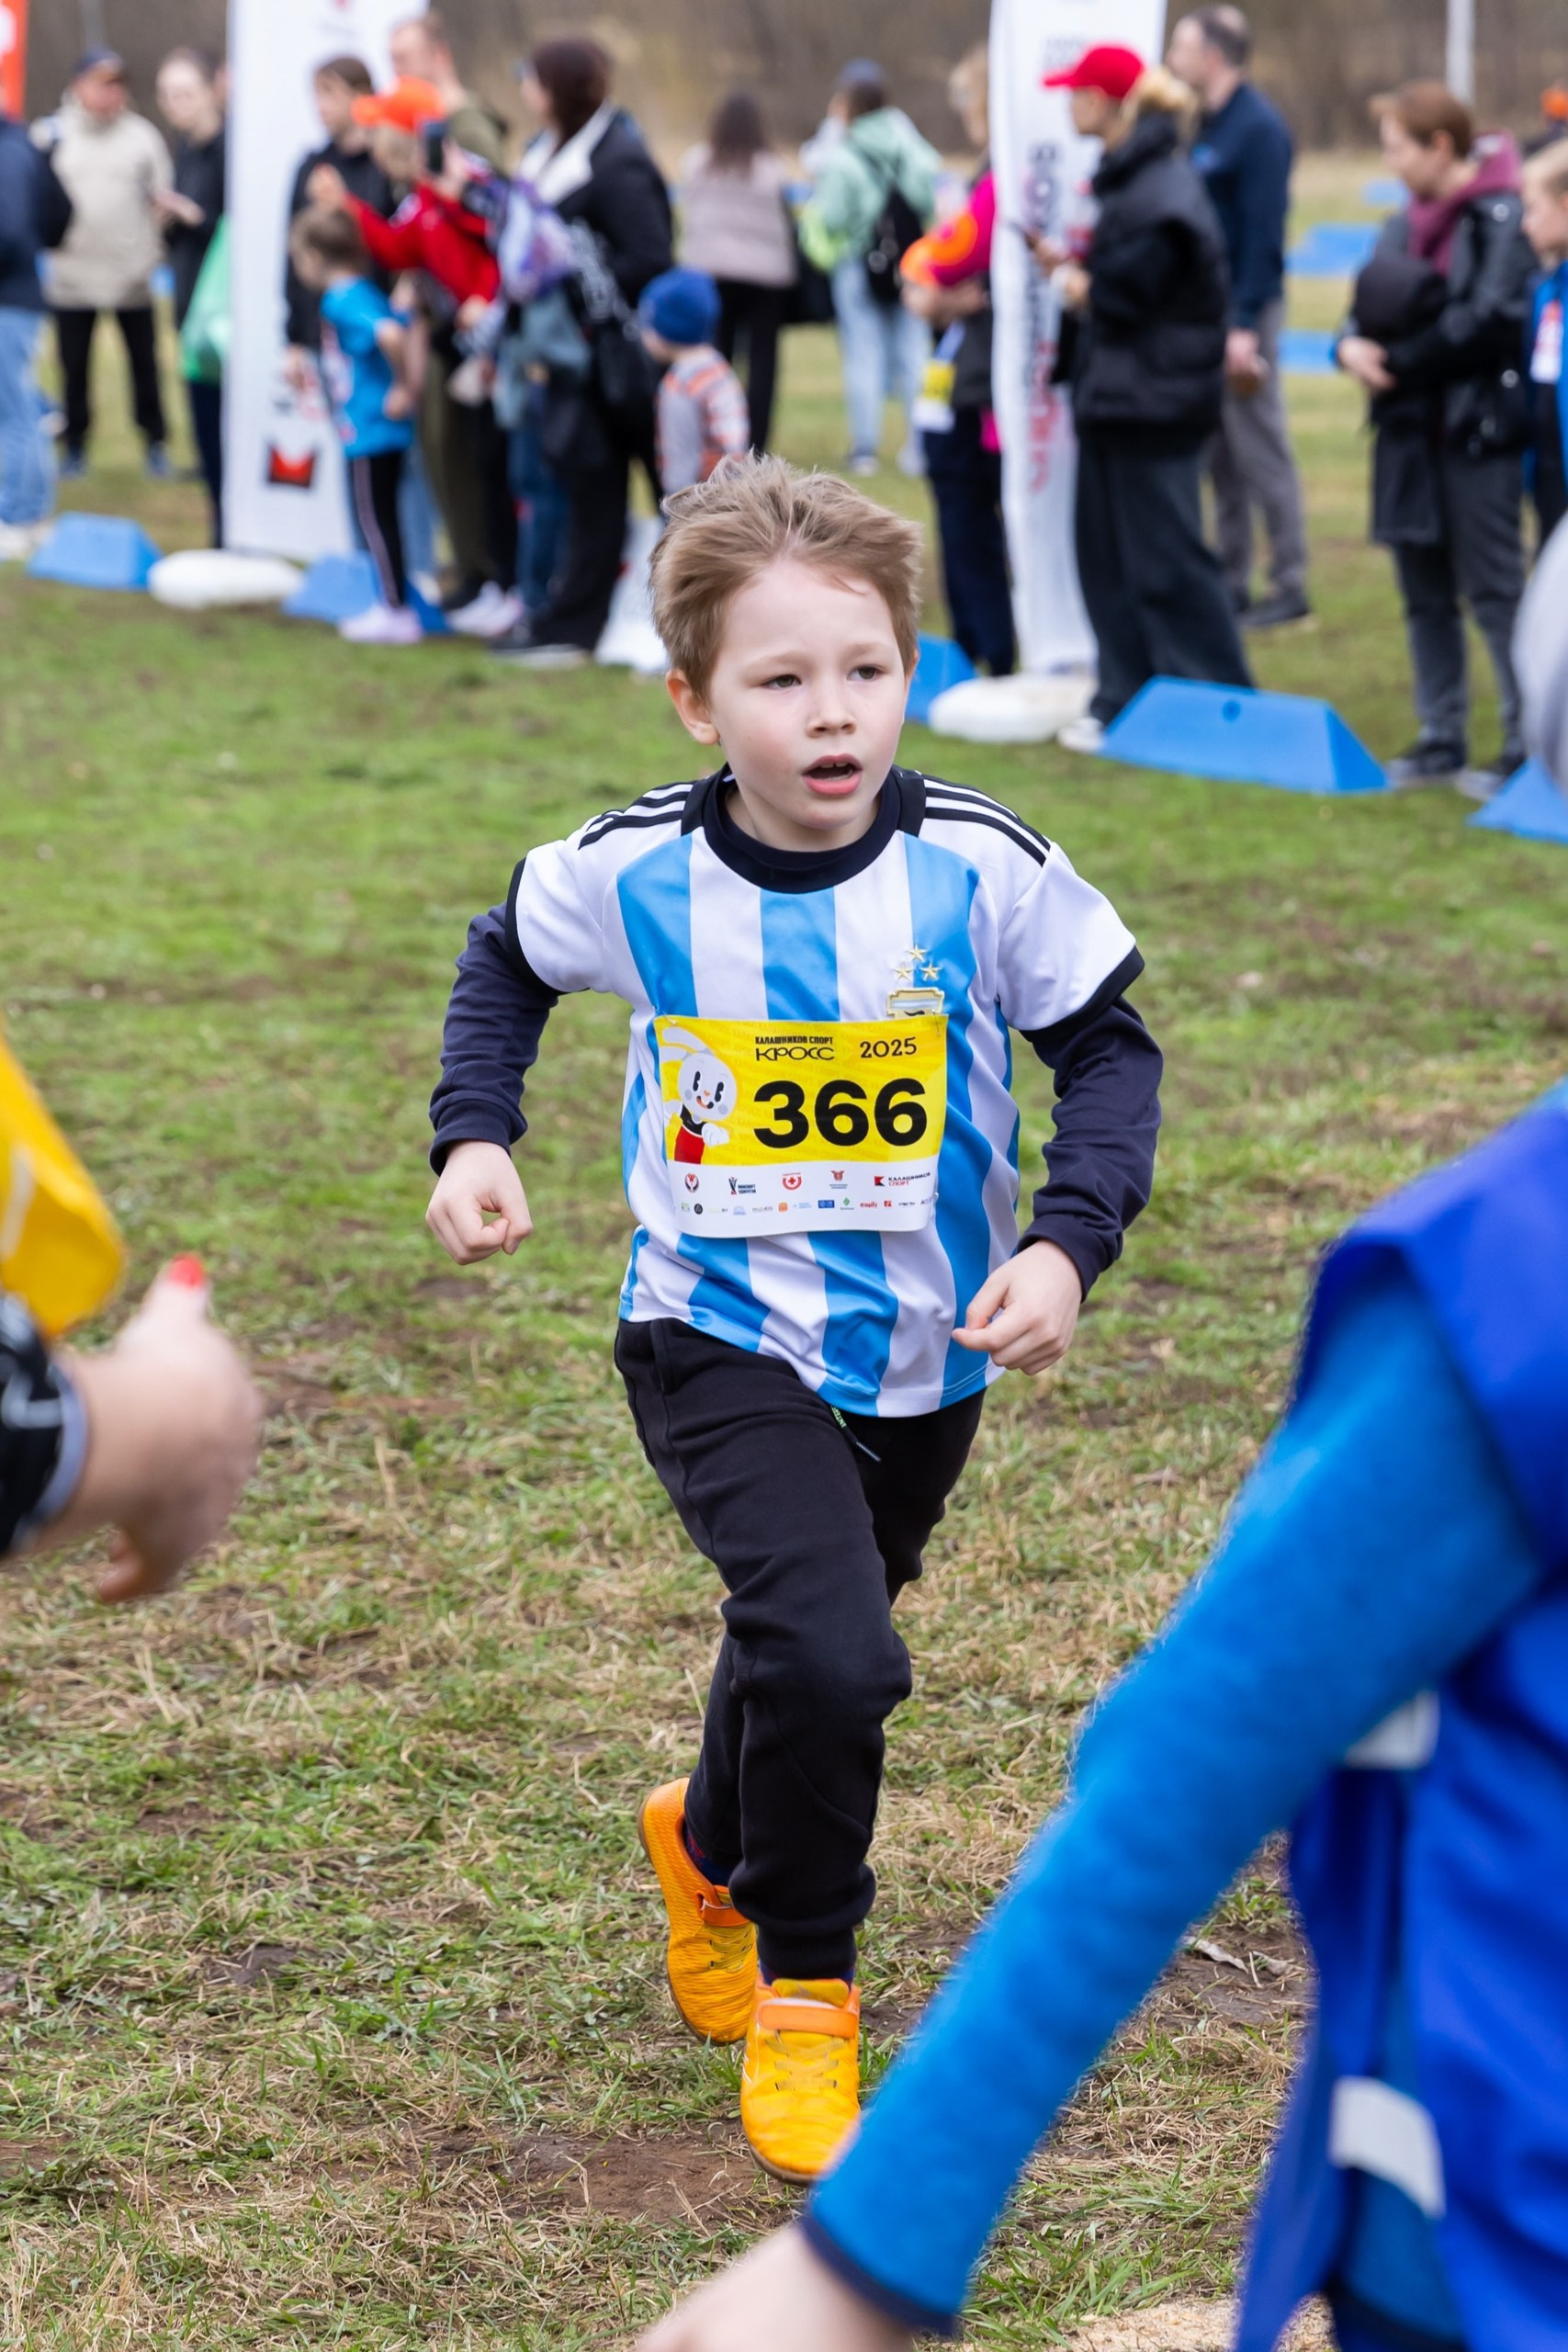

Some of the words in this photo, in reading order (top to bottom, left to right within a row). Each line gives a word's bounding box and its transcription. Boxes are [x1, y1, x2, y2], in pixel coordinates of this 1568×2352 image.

[755, 1035, 807, 1045] КАЛАШНИКОВ
[809, 1036, 833, 1045] СПОРТ
[860, 1036, 917, 1058] 2025
[755, 1046, 835, 1061] КРОСС
[753, 1078, 928, 1148] 366
